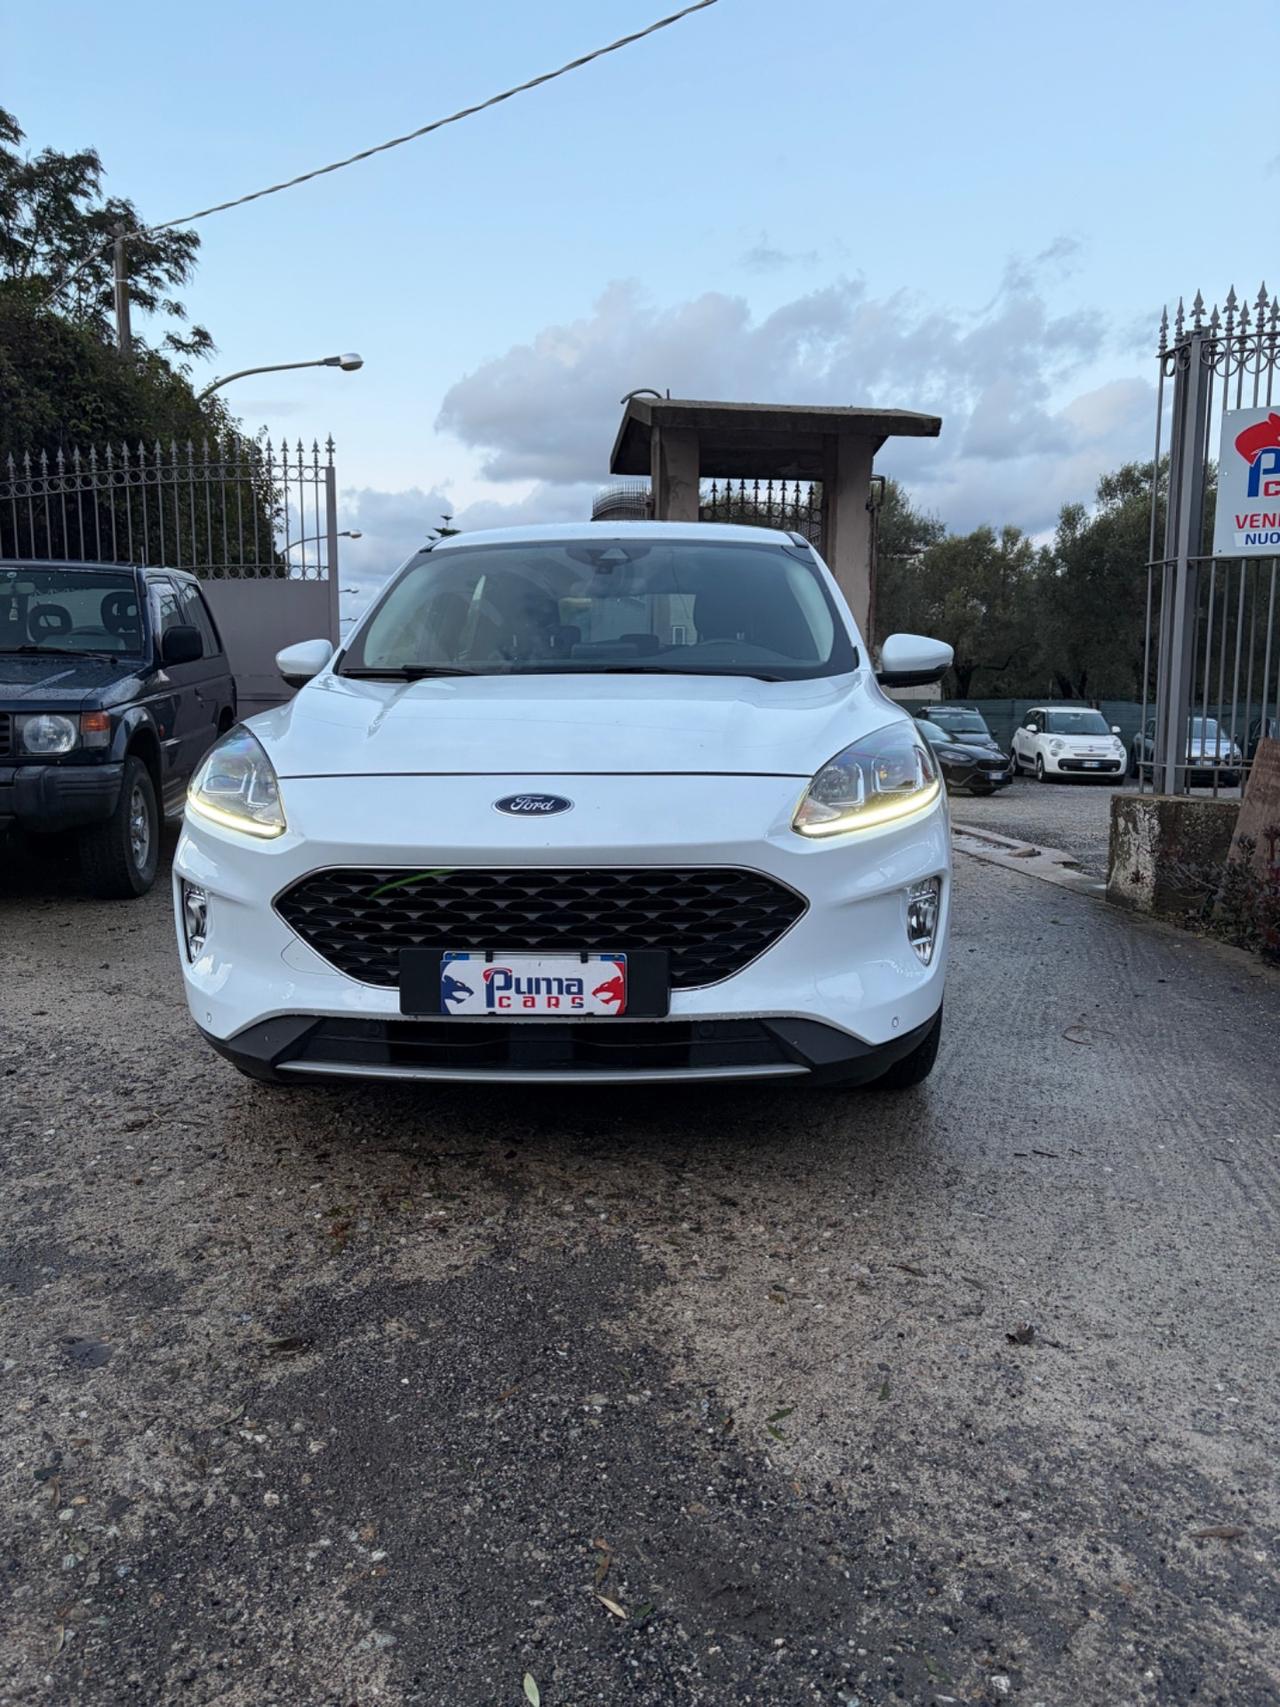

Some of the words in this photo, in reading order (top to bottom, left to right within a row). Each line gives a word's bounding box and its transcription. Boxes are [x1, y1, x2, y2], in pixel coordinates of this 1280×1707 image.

[1235, 512, 1280, 529] VEN
[510, 796, 555, 811] Ford
[484, 967, 584, 1008] Puma
